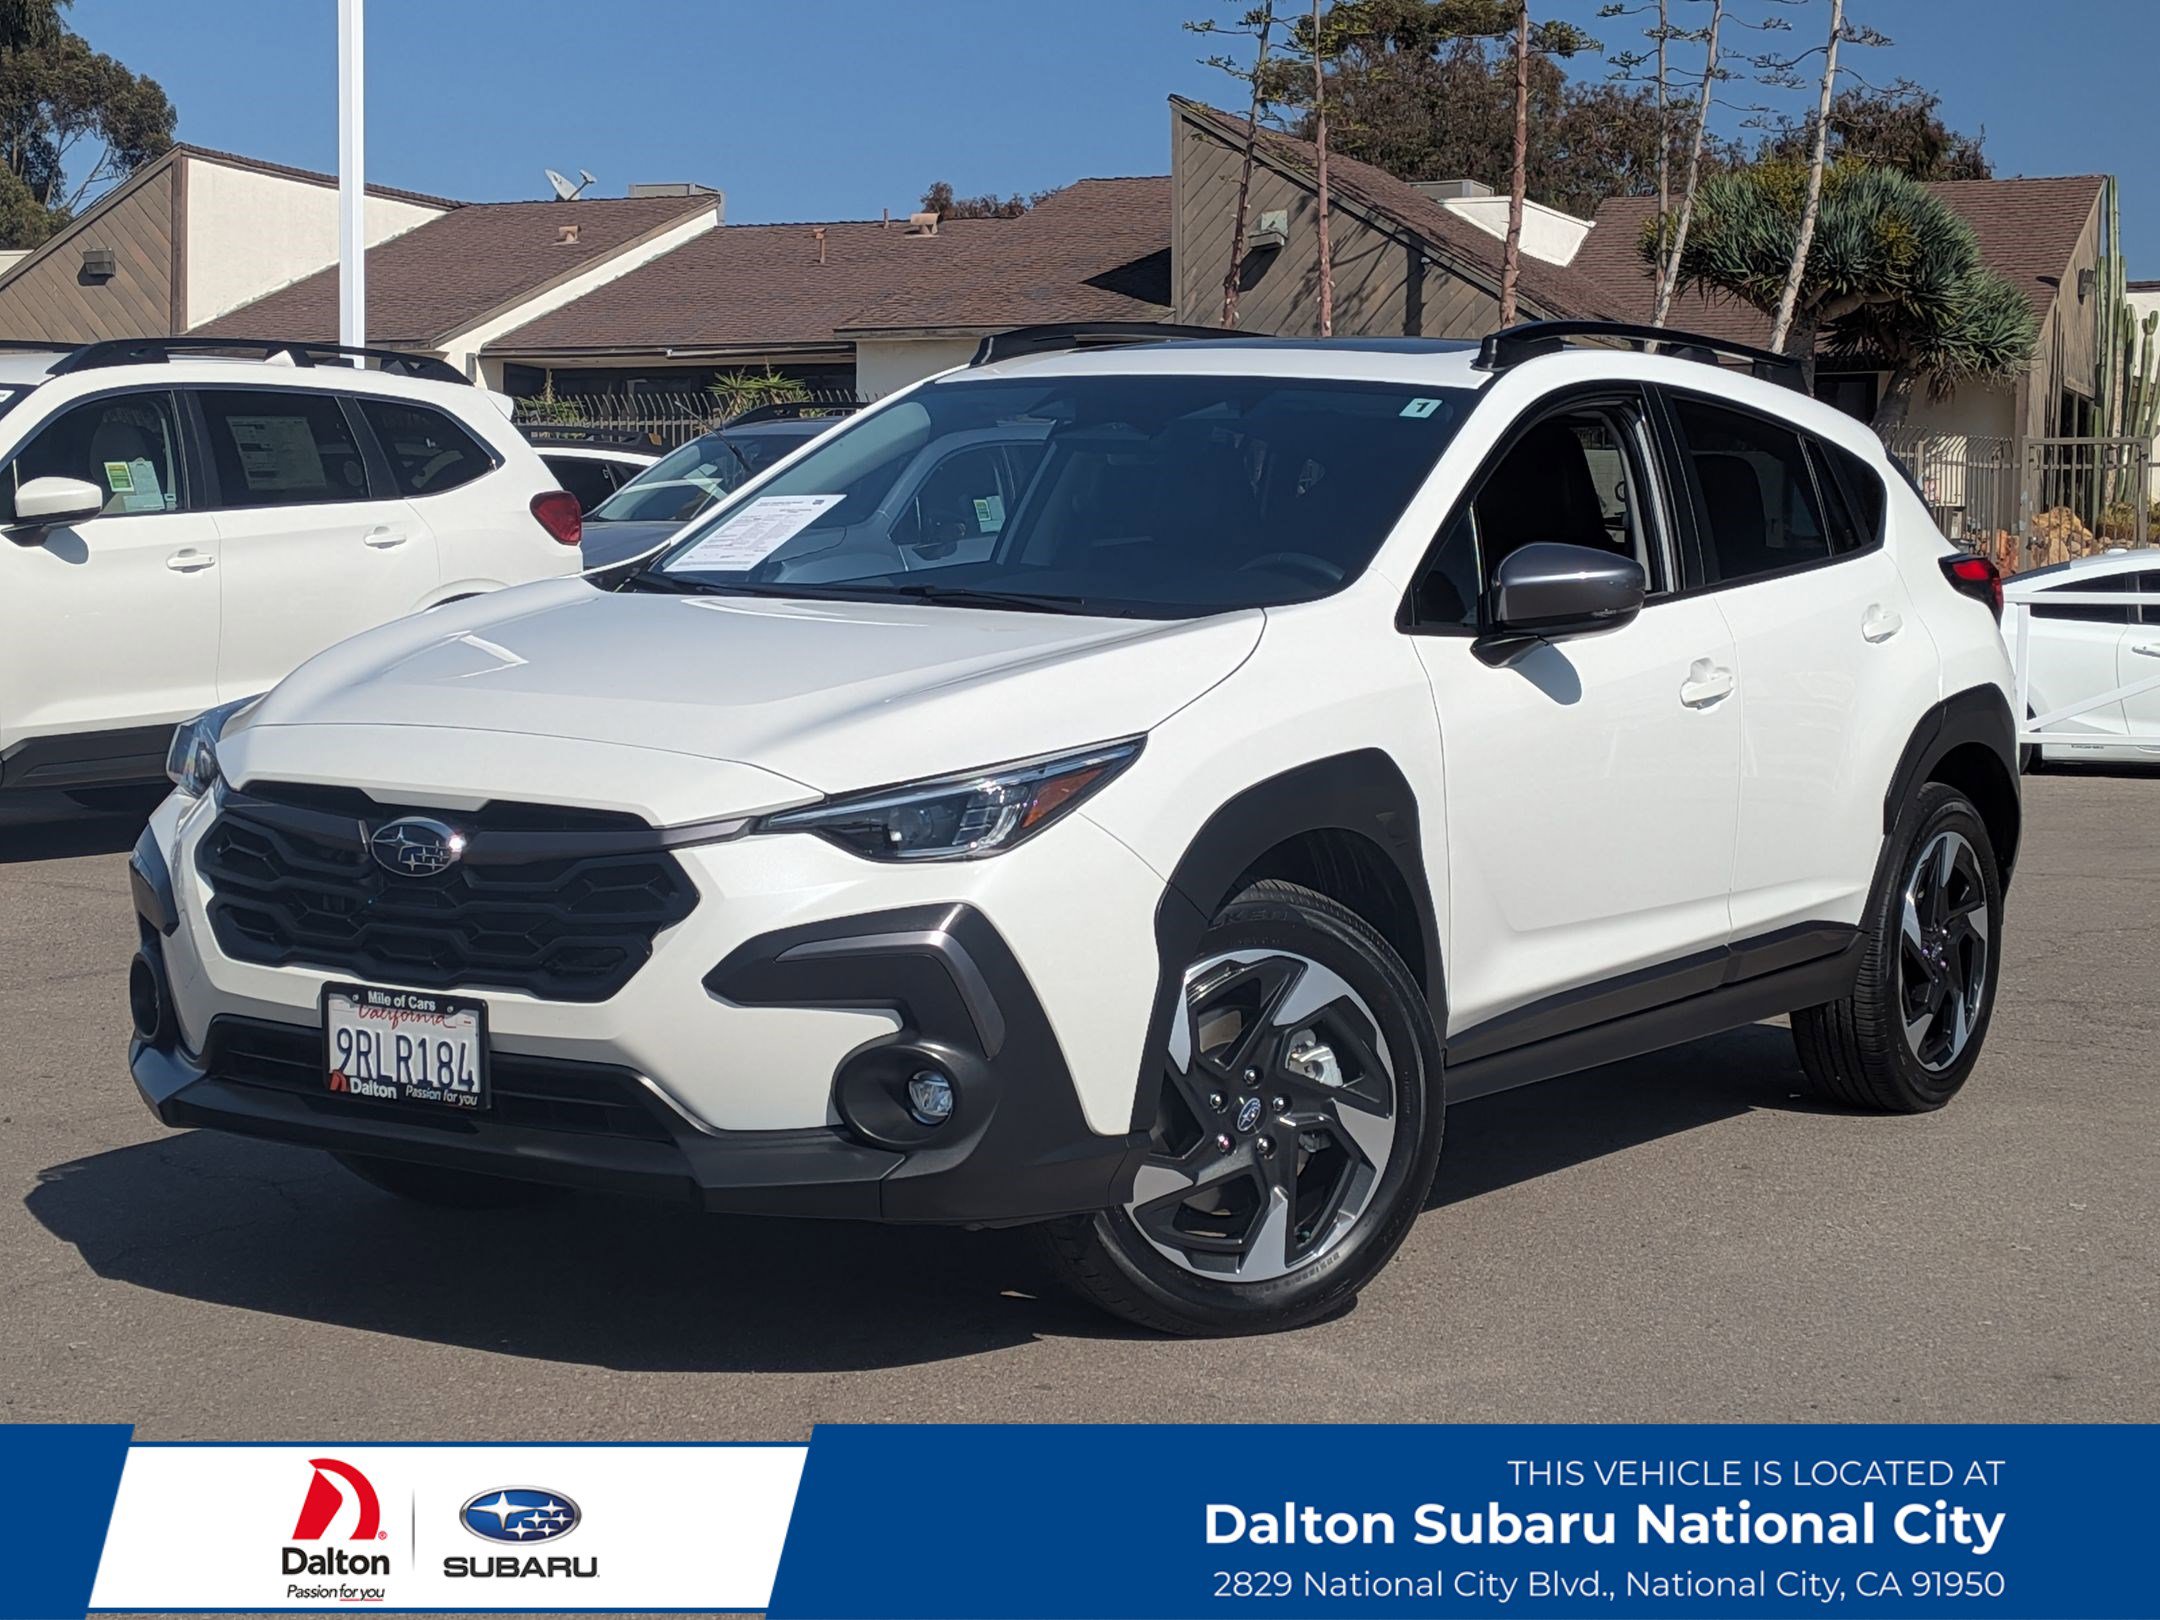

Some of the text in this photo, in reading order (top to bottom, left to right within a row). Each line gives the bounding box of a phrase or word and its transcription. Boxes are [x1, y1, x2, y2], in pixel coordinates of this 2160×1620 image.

[367, 990, 436, 1012] Mile of Cars
[336, 1027, 475, 1090] 9RLR184
[350, 1077, 478, 1106] Dalton Passion for you
